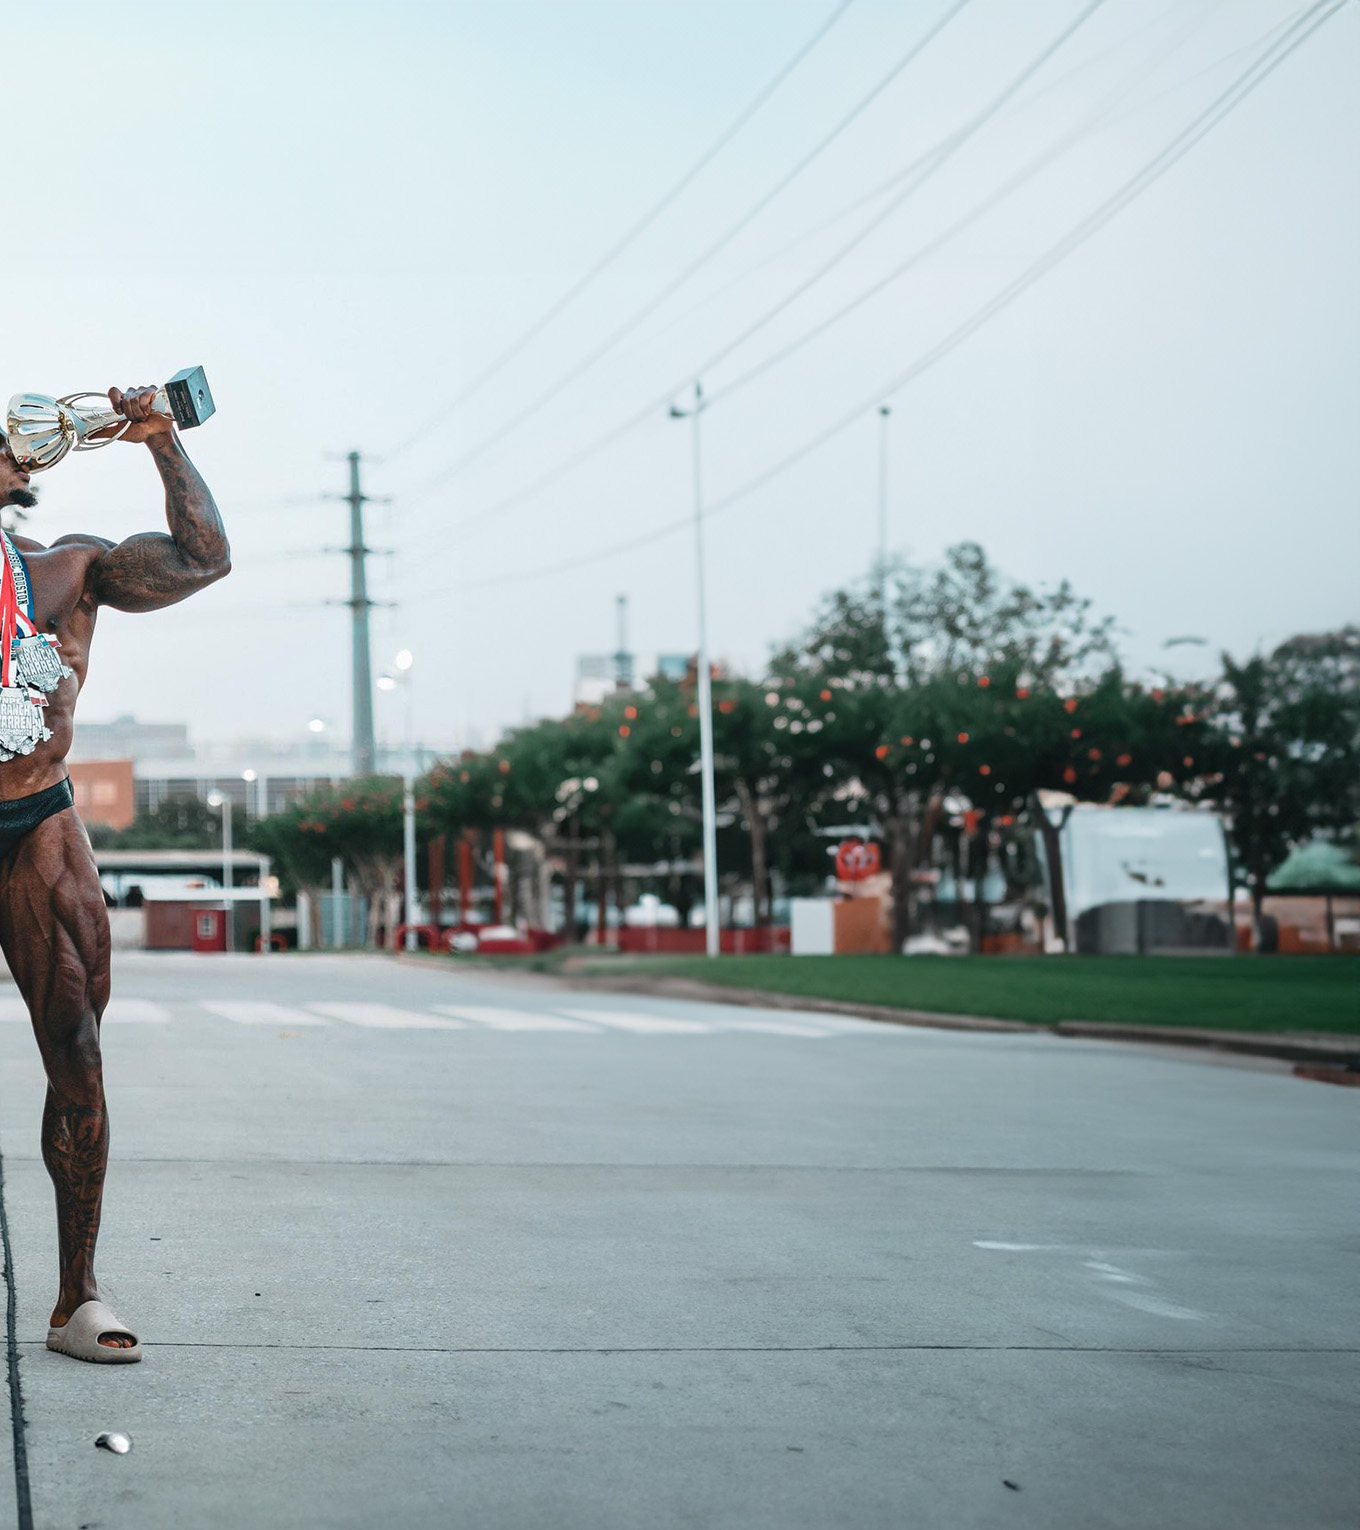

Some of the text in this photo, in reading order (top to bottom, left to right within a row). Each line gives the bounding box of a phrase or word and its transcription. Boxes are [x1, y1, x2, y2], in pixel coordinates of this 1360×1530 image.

[13, 570, 29, 606] HOUSTON
[19, 648, 54, 665] BRANCH
[20, 660, 61, 676] WARREN
